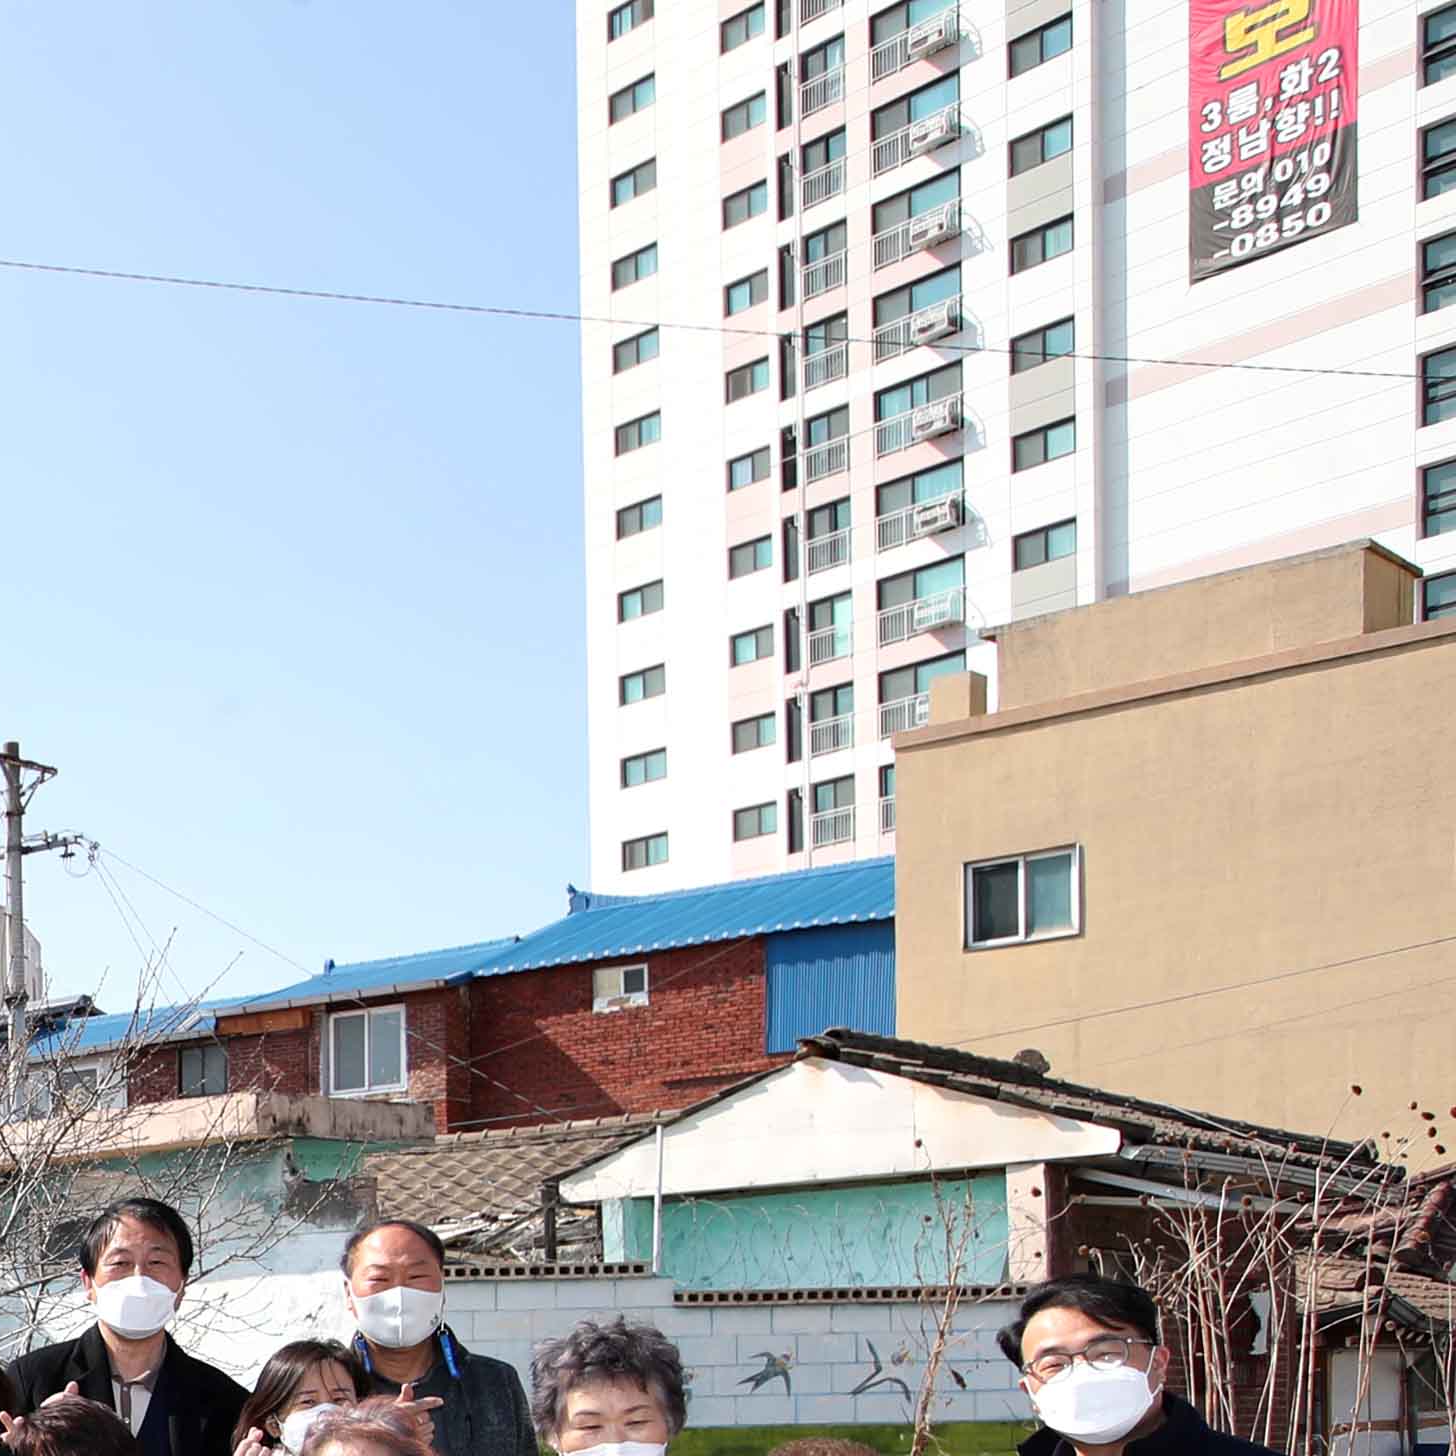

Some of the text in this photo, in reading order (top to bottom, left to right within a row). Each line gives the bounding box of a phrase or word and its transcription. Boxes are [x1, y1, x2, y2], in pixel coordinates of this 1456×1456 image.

[1201, 88, 1340, 174] 정남향!!
[1212, 172, 1331, 231] -8949
[1213, 142, 1332, 211] 문의 010
[1212, 202, 1333, 259] -0850
